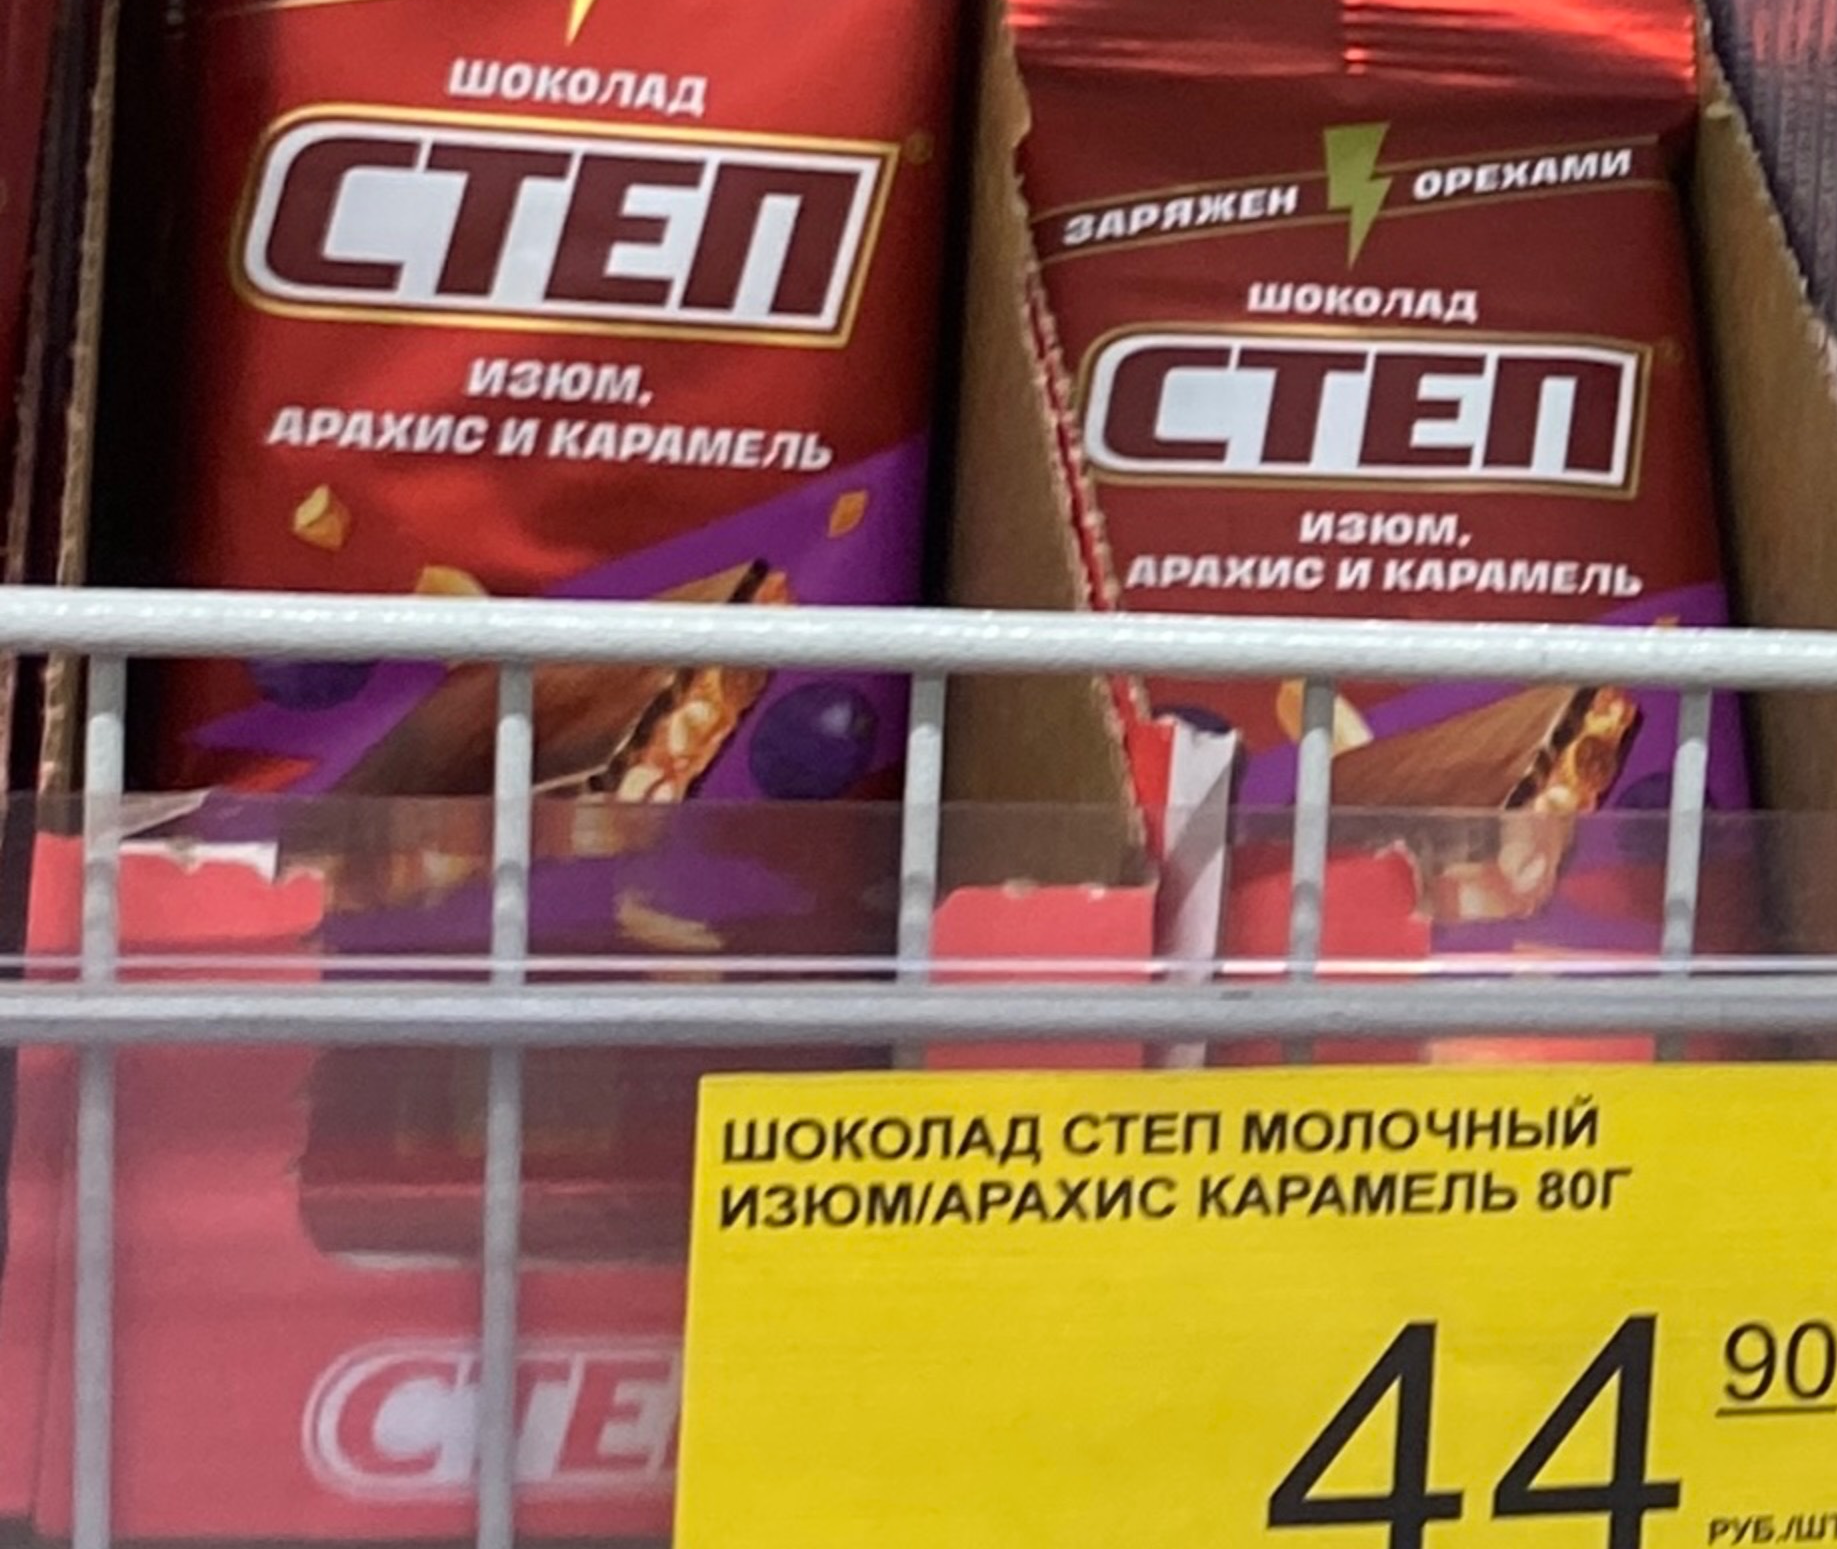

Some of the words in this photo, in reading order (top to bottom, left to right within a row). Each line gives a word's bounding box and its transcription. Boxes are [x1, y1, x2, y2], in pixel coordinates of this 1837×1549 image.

[448, 58, 707, 117] ШОКОЛАД
[258, 132, 868, 318] СТЕП
[1062, 185, 1299, 247] ЗАРЯЖЕН
[1412, 149, 1633, 202] ОРЕХАМИ
[1247, 282, 1479, 323] ШОКОЛАД
[466, 358, 652, 408] ИЗЮМ,
[1100, 345, 1626, 475] СТЕП
[267, 408, 487, 455] АРАХИС
[499, 418, 537, 455] И
[547, 419, 834, 472] КАРАМЕЛЬ
[1299, 512, 1473, 548] ИЗЮМ,
[1125, 557, 1326, 592] АРАХИС
[1335, 558, 1369, 591] И
[1380, 557, 1644, 597] КАРАМЕЛЬ
[722, 1116, 1041, 1166] ШОКОЛАД
[1062, 1112, 1221, 1156] СТЕП
[1242, 1095, 1599, 1153] МОЛОЧНЫЙ
[720, 1176, 1177, 1229] ИЗЮМ/АРАХИС
[1198, 1172, 1518, 1219] КАРАМЕЛЬ
[1537, 1166, 1632, 1211] 80Г
[1267, 1312, 1682, 1549] 44
